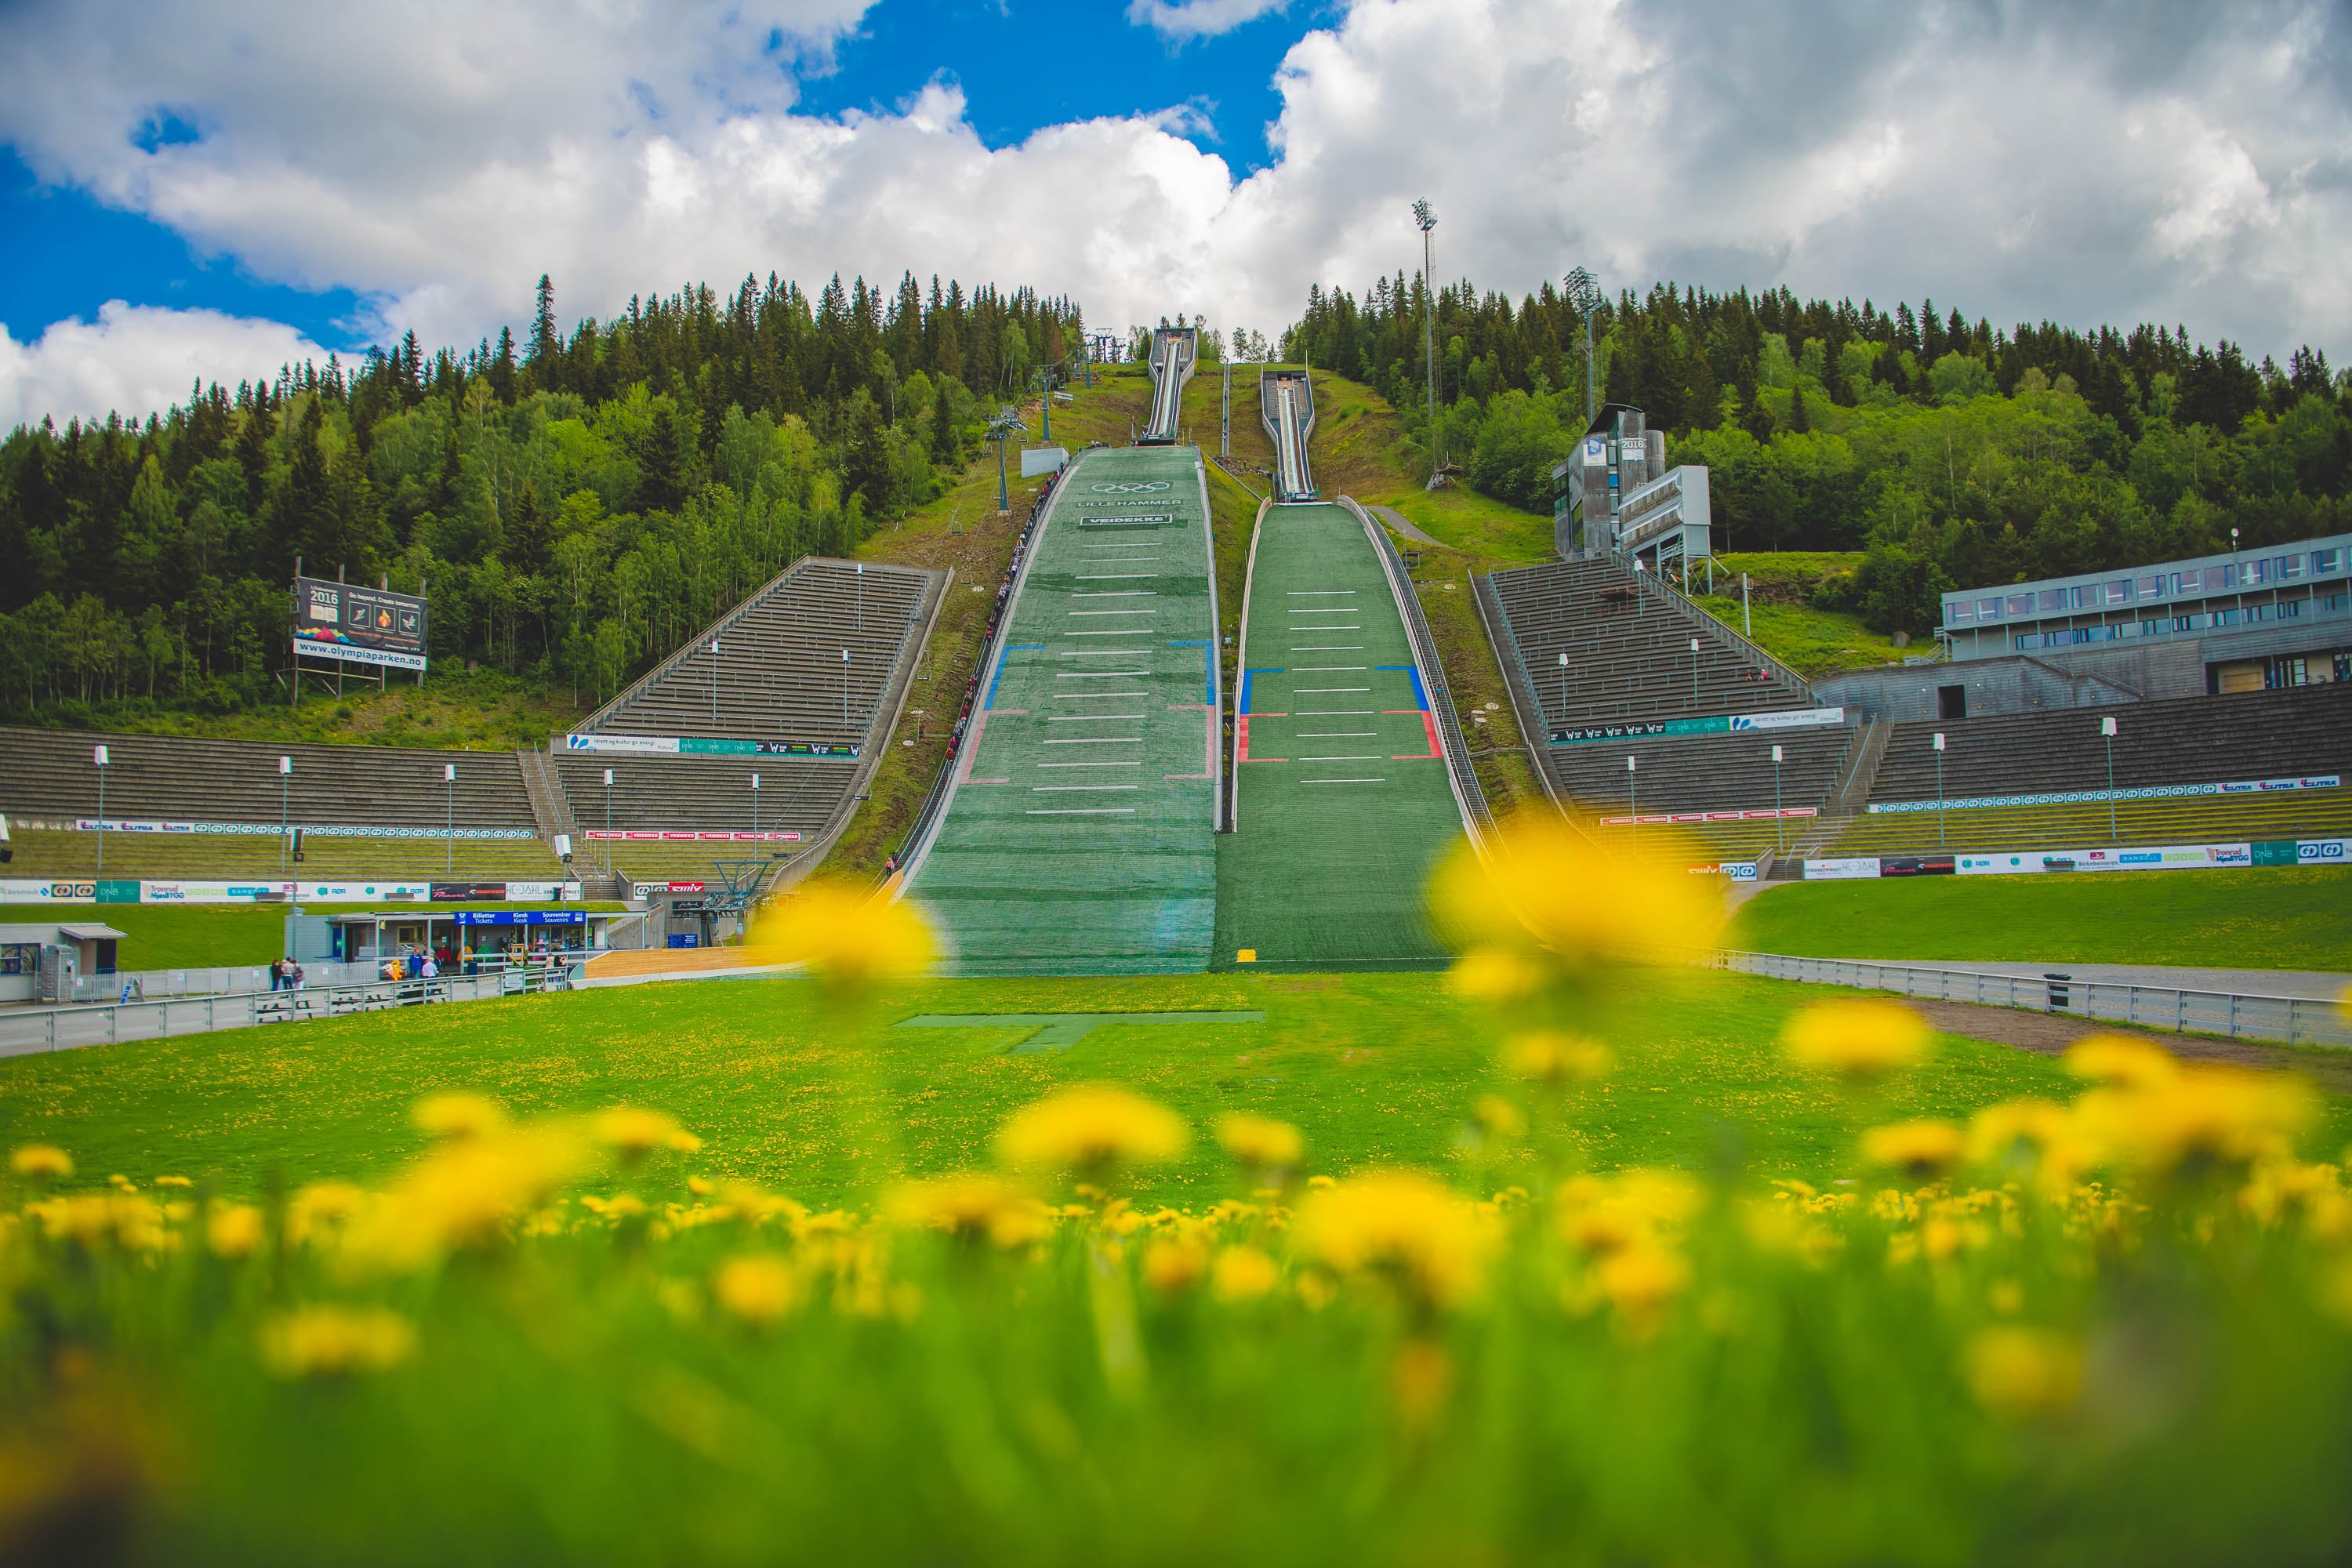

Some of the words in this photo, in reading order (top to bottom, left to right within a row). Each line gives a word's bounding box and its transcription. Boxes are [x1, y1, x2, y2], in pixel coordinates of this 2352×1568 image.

[310, 590, 339, 604] 2016
[299, 642, 421, 666] www.olympiaparken.no
[2299, 845, 2318, 857] GD
[2322, 844, 2340, 855] GD
[1741, 867, 1755, 876] GD
[53, 885, 71, 896] GD
[76, 885, 94, 896] GD
